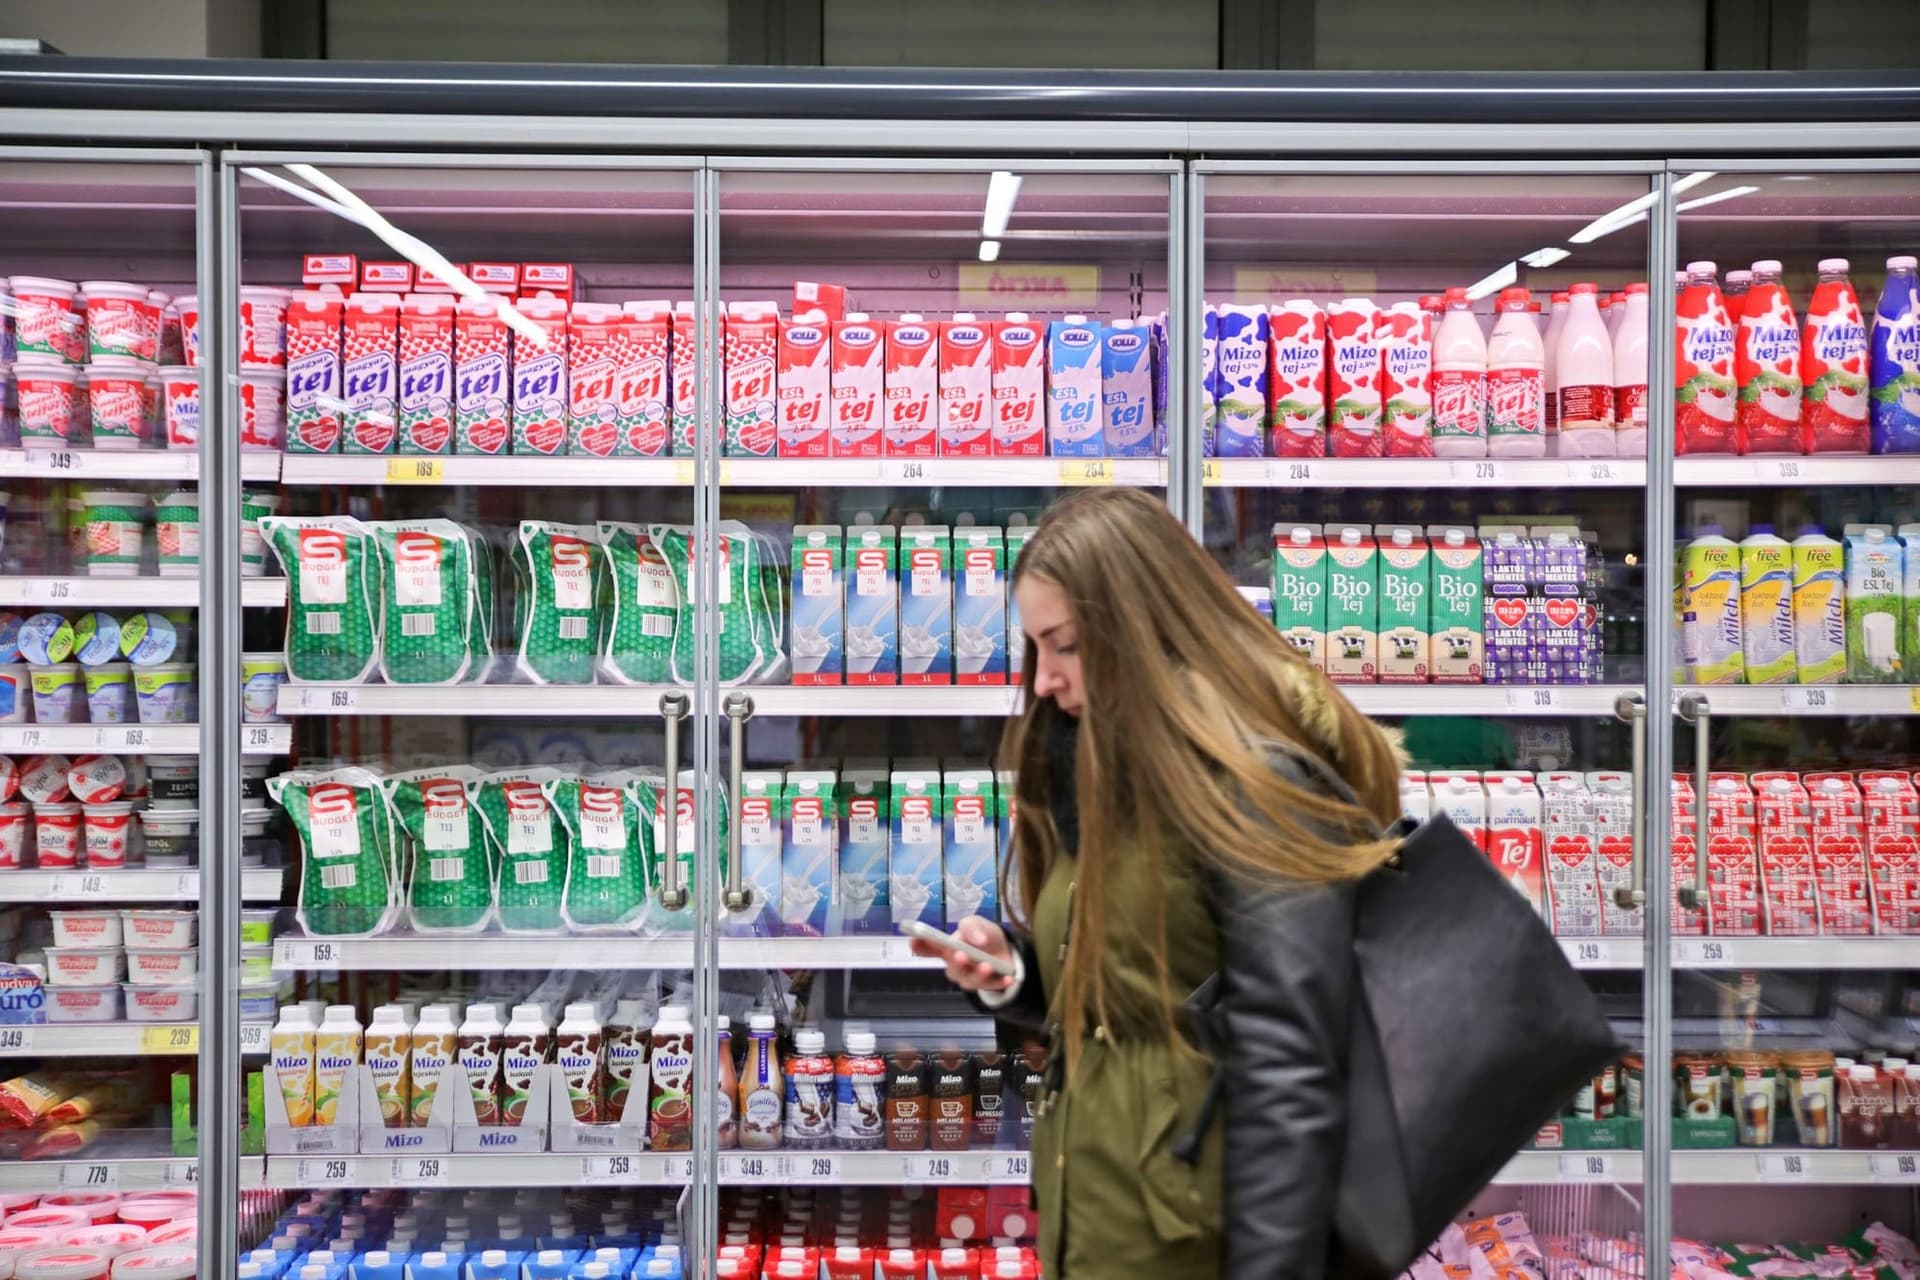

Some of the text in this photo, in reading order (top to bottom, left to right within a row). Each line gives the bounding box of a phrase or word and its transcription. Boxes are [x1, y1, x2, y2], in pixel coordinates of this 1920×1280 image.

[1690, 325, 1733, 344] Mizo
[1753, 325, 1798, 344] Mizo
[1820, 324, 1865, 343] Mizo
[1224, 346, 1261, 361] Mizo
[1280, 346, 1319, 361] Mizo
[1339, 346, 1377, 361] Mizo
[1390, 346, 1428, 361] Mizo
[1692, 345, 1716, 362] tej
[1756, 345, 1779, 361] tej
[1822, 344, 1847, 359] tej
[1897, 344, 1920, 361] tej
[1225, 361, 1241, 374] tej
[1283, 360, 1299, 374] tej
[1341, 360, 1358, 374] tej
[1393, 360, 1408, 374] tej
[292, 361, 334, 396] tej
[348, 362, 390, 397] tej
[403, 362, 446, 398] tej
[460, 363, 502, 400] tej
[518, 364, 560, 401] tej
[621, 367, 662, 404] tej
[731, 367, 773, 403] tej
[573, 368, 615, 405] tej
[781, 388, 803, 399] ESL
[834, 388, 857, 399] ESL
[888, 388, 911, 399] ESL
[944, 388, 966, 399] ESL
[996, 388, 1018, 399] ESL
[1055, 388, 1078, 399] ESL
[1105, 392, 1127, 404] ESL
[786, 393, 822, 422] tej
[839, 393, 876, 422] tej
[893, 393, 930, 422] tej
[1000, 393, 1036, 422] tej
[1060, 393, 1096, 422] tej
[1111, 397, 1145, 426] tej
[50, 453, 71, 469] 349
[416, 462, 433, 476] 189
[903, 464, 923, 478] 264
[1476, 464, 1495, 478] 279
[1704, 549, 1728, 562] free
[1757, 549, 1780, 562] free
[1806, 549, 1832, 562] free
[640, 567, 671, 576] BUDGE
[1871, 568, 1885, 578] Bio
[50, 583, 69, 598] 315
[1281, 573, 1321, 597] Bio
[1332, 573, 1371, 597] Bio
[1384, 573, 1424, 597] Bio
[1439, 575, 1477, 597] Bio
[1863, 579, 1894, 591] ESL Tej
[1289, 595, 1313, 615] Tej
[1339, 595, 1364, 615] Tej
[1391, 596, 1416, 615] Tej
[1447, 596, 1471, 614] Tej
[1722, 598, 1739, 645] Milch
[1776, 598, 1793, 645] Milch
[1825, 597, 1843, 645] Milch
[1534, 690, 1551, 705] 319
[313, 815, 353, 826] BUDGET
[427, 811, 465, 821] BUDGET
[583, 814, 620, 824] BUDGET
[1494, 815, 1536, 825] parmalat
[1499, 837, 1532, 869] Tej
[1578, 944, 1598, 959] 249
[1703, 944, 1722, 959] 259
[170, 1029, 190, 1045] 239
[609, 1046, 639, 1058] Mizo
[276, 1056, 307, 1069] Mizo
[320, 1056, 352, 1069] Mizo
[368, 1057, 398, 1070] Mizo
[414, 1057, 445, 1070] Mizo
[462, 1057, 492, 1068] Mizo
[506, 1057, 537, 1069] Mizo
[560, 1056, 590, 1068] Mizo
[657, 1056, 688, 1069] Mizo
[896, 1075, 918, 1083] Mizo
[940, 1075, 962, 1083] Mizo
[980, 1069, 1001, 1077] Mizo
[385, 1134, 423, 1148] Mizo
[479, 1132, 517, 1147] Mizo
[326, 1161, 346, 1178] 259
[419, 1160, 439, 1176] 259
[610, 1157, 629, 1174] 259
[812, 1159, 830, 1175] 299
[929, 1159, 949, 1175] 249
[1007, 1158, 1027, 1174] 249
[1587, 1157, 1603, 1173] 189
[1784, 1156, 1801, 1172] 189
[1899, 1156, 1915, 1172] 199
[87, 1167, 107, 1184] 779
